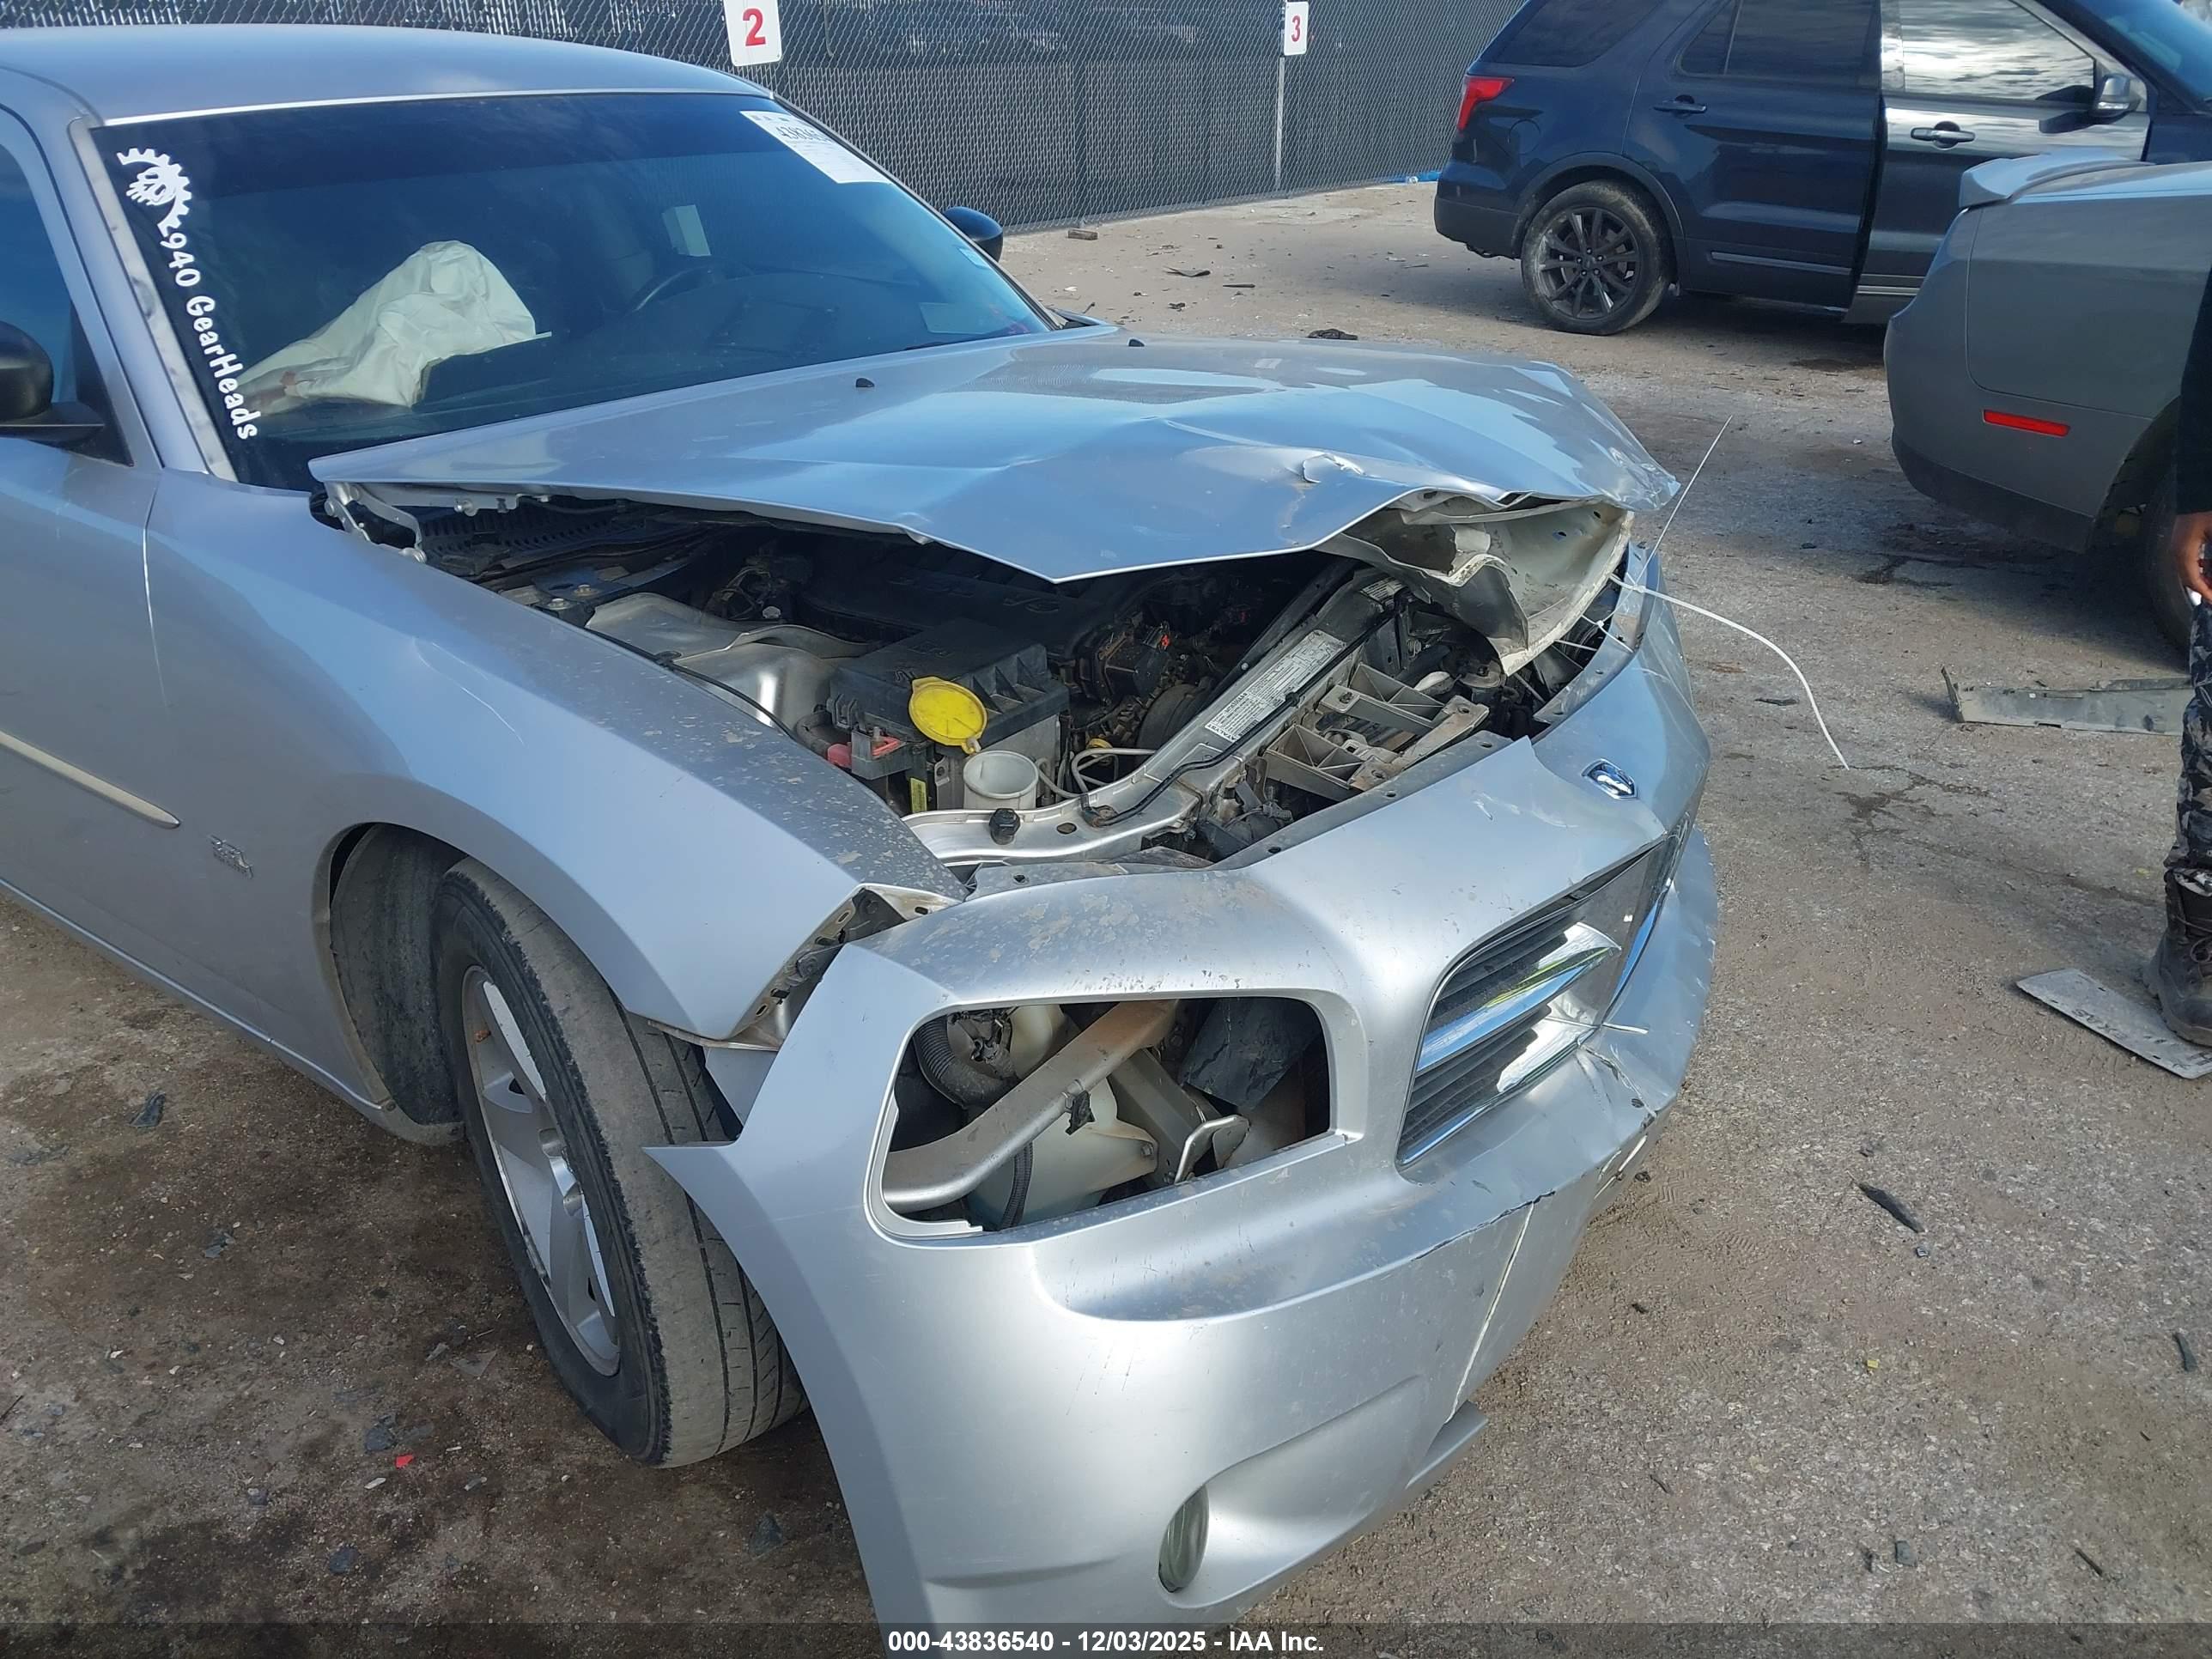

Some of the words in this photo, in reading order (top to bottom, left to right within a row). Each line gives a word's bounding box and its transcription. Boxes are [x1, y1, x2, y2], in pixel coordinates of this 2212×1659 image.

[742, 8, 766, 46] 2
[1291, 15, 1301, 42] 3
[160, 232, 201, 287] 940
[185, 295, 261, 440] GearHeads
[1206, 724, 1237, 741] ATALYST
